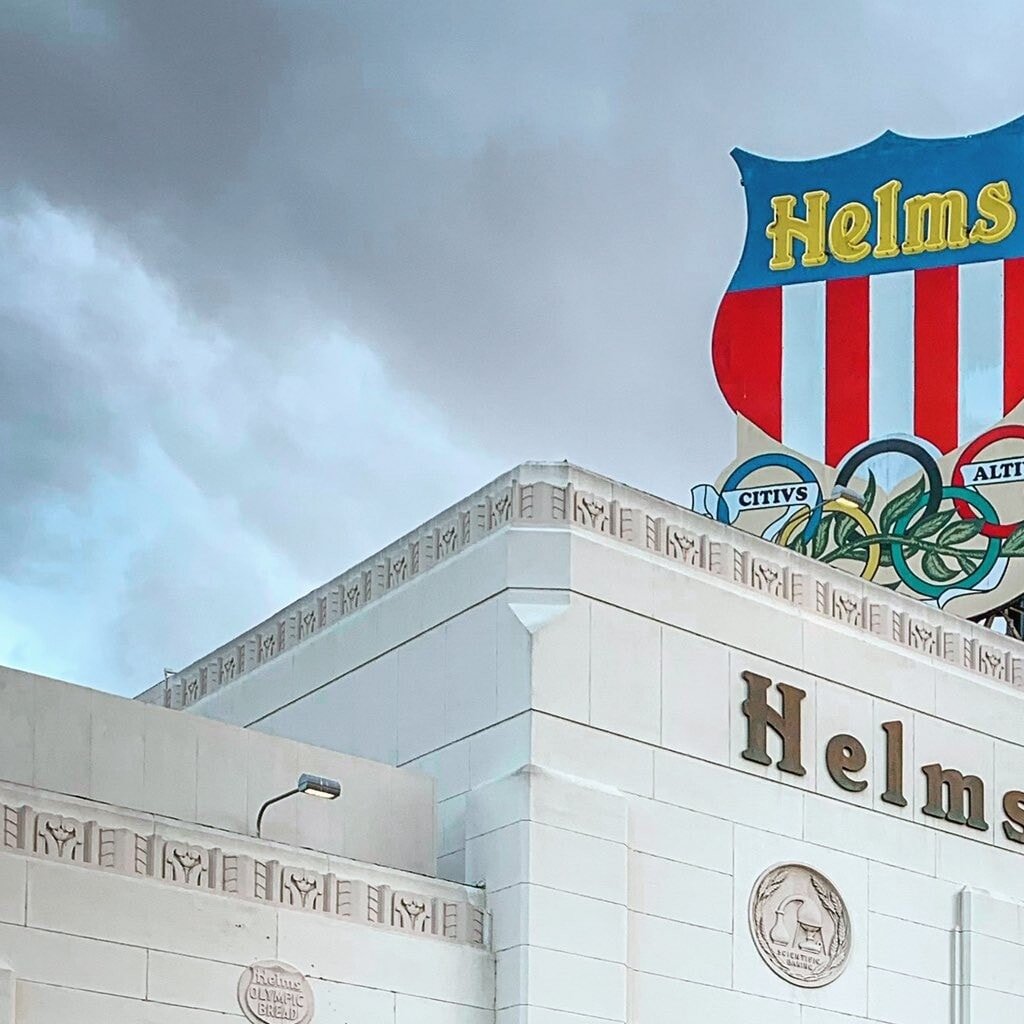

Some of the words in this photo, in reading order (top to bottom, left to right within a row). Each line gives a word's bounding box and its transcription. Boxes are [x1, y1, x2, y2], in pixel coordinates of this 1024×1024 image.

[765, 179, 1017, 271] Helms
[738, 486, 809, 508] CITIVS
[255, 969, 301, 992] Helms
[249, 987, 304, 1008] OLYMPIC
[258, 1002, 298, 1020] BREAD
